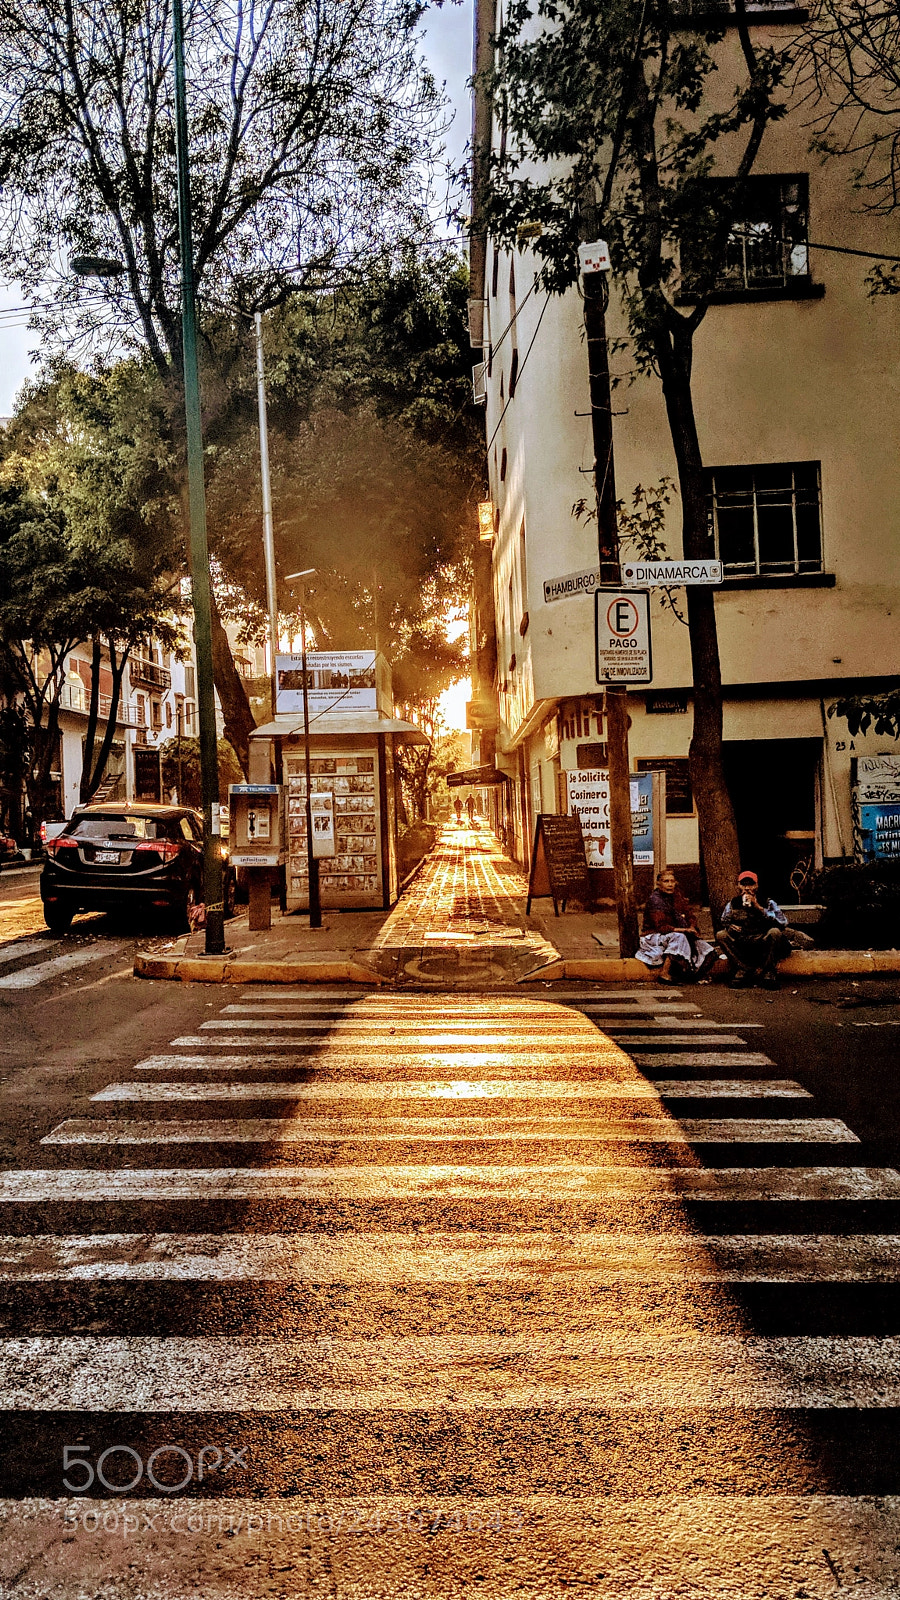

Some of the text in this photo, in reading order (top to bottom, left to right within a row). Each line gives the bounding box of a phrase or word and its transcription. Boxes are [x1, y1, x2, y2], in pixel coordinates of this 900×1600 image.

[636, 566, 708, 580] DINAMARCA
[551, 573, 595, 596] HAMBURGO
[616, 602, 629, 632] E
[609, 638, 638, 648] PAGO
[569, 773, 577, 783] Se
[570, 804, 600, 815] Mesera
[579, 819, 611, 830] udant
